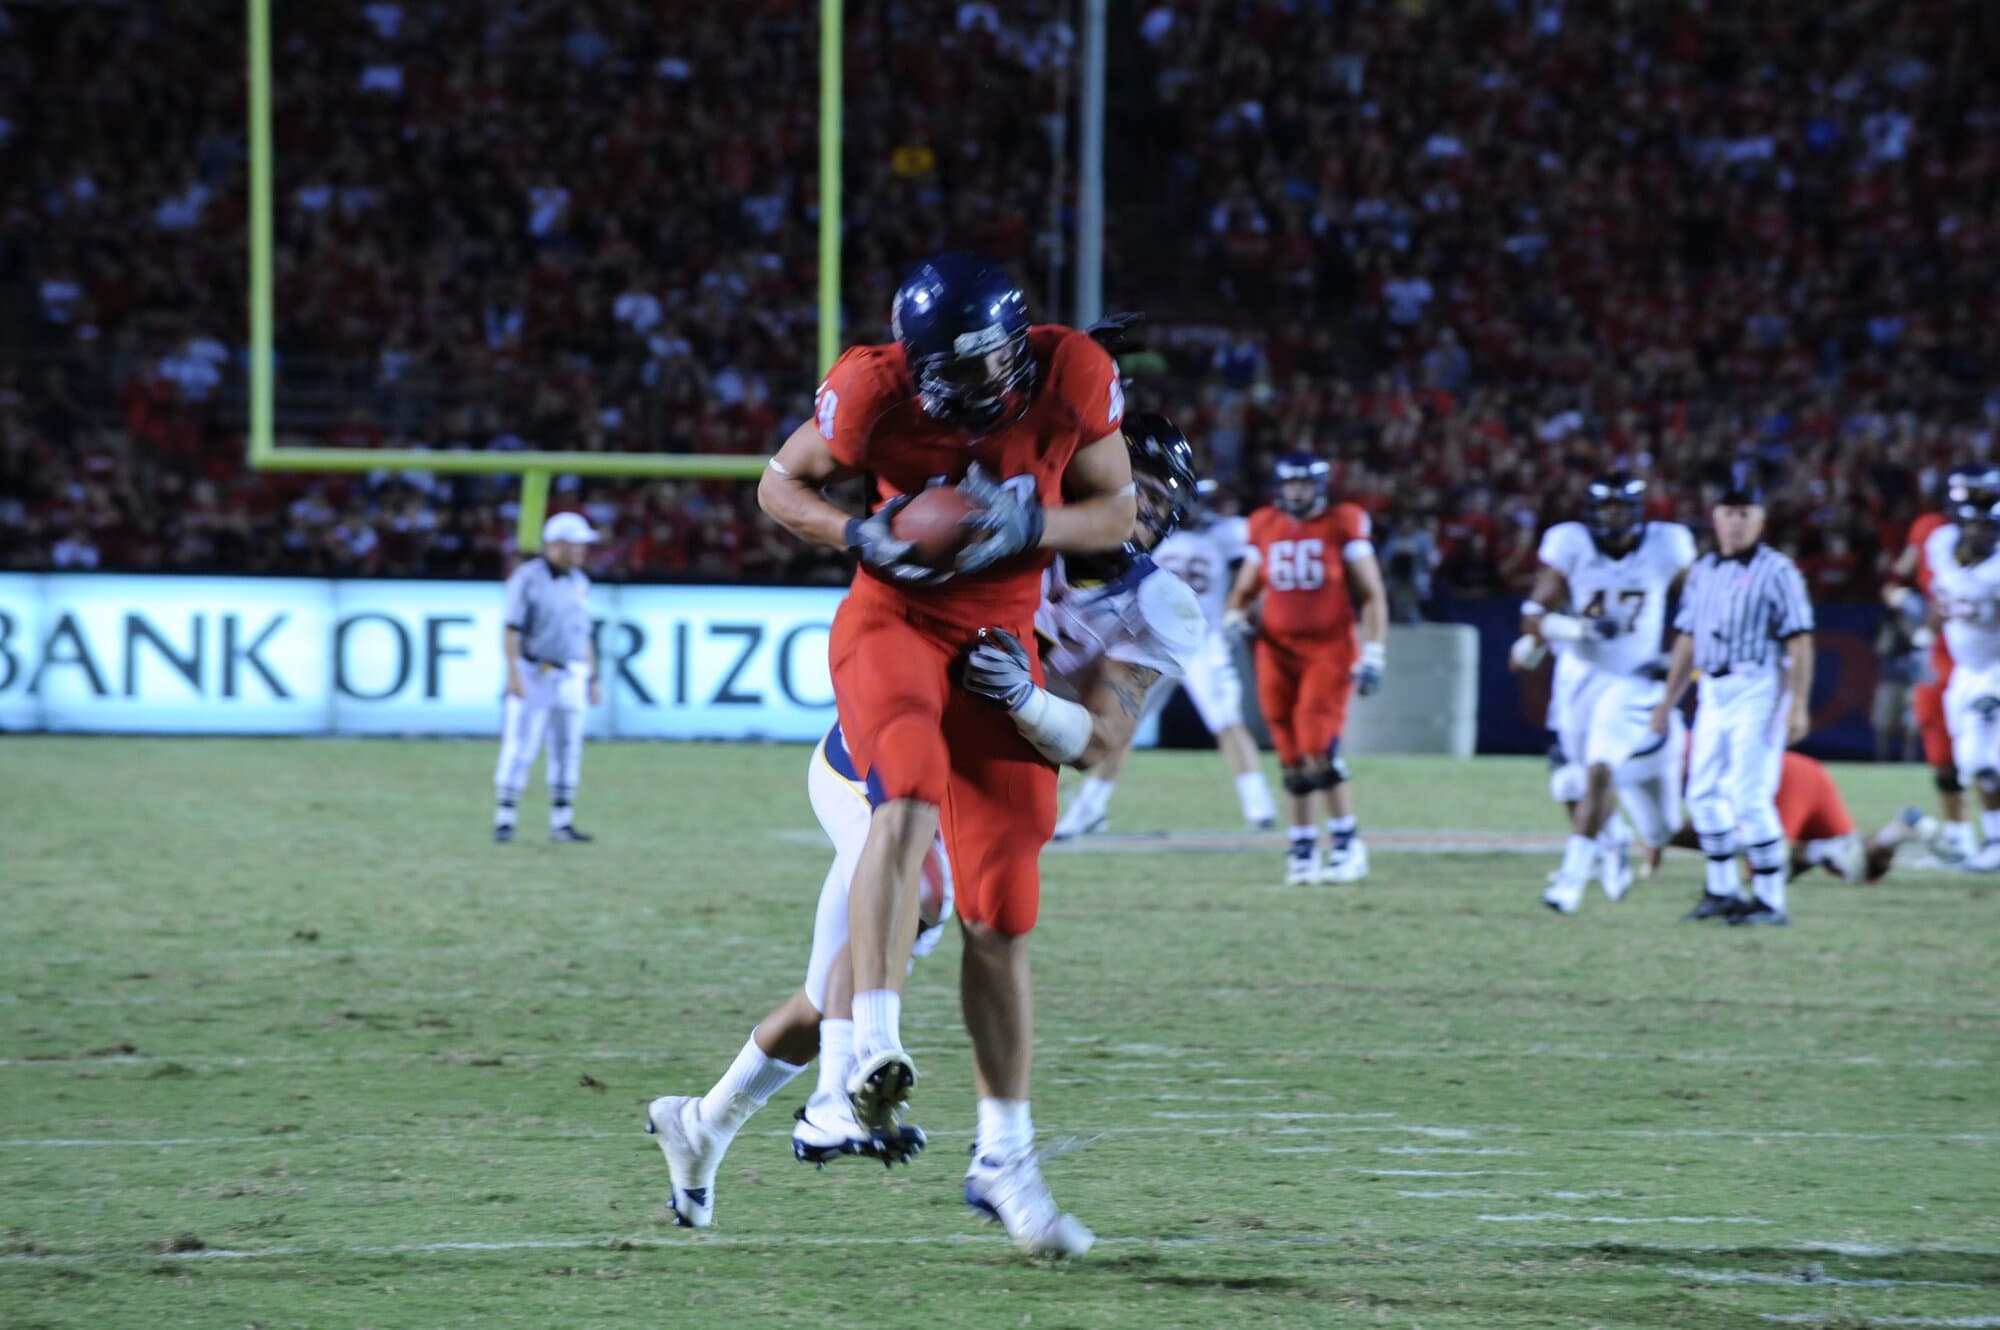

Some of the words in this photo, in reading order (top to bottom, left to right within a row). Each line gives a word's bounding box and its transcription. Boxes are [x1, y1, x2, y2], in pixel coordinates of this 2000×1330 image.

[1268, 539, 1325, 592] 66
[1583, 589, 1646, 634] 47
[333, 612, 474, 700] OF
[591, 618, 838, 708] RIZO
